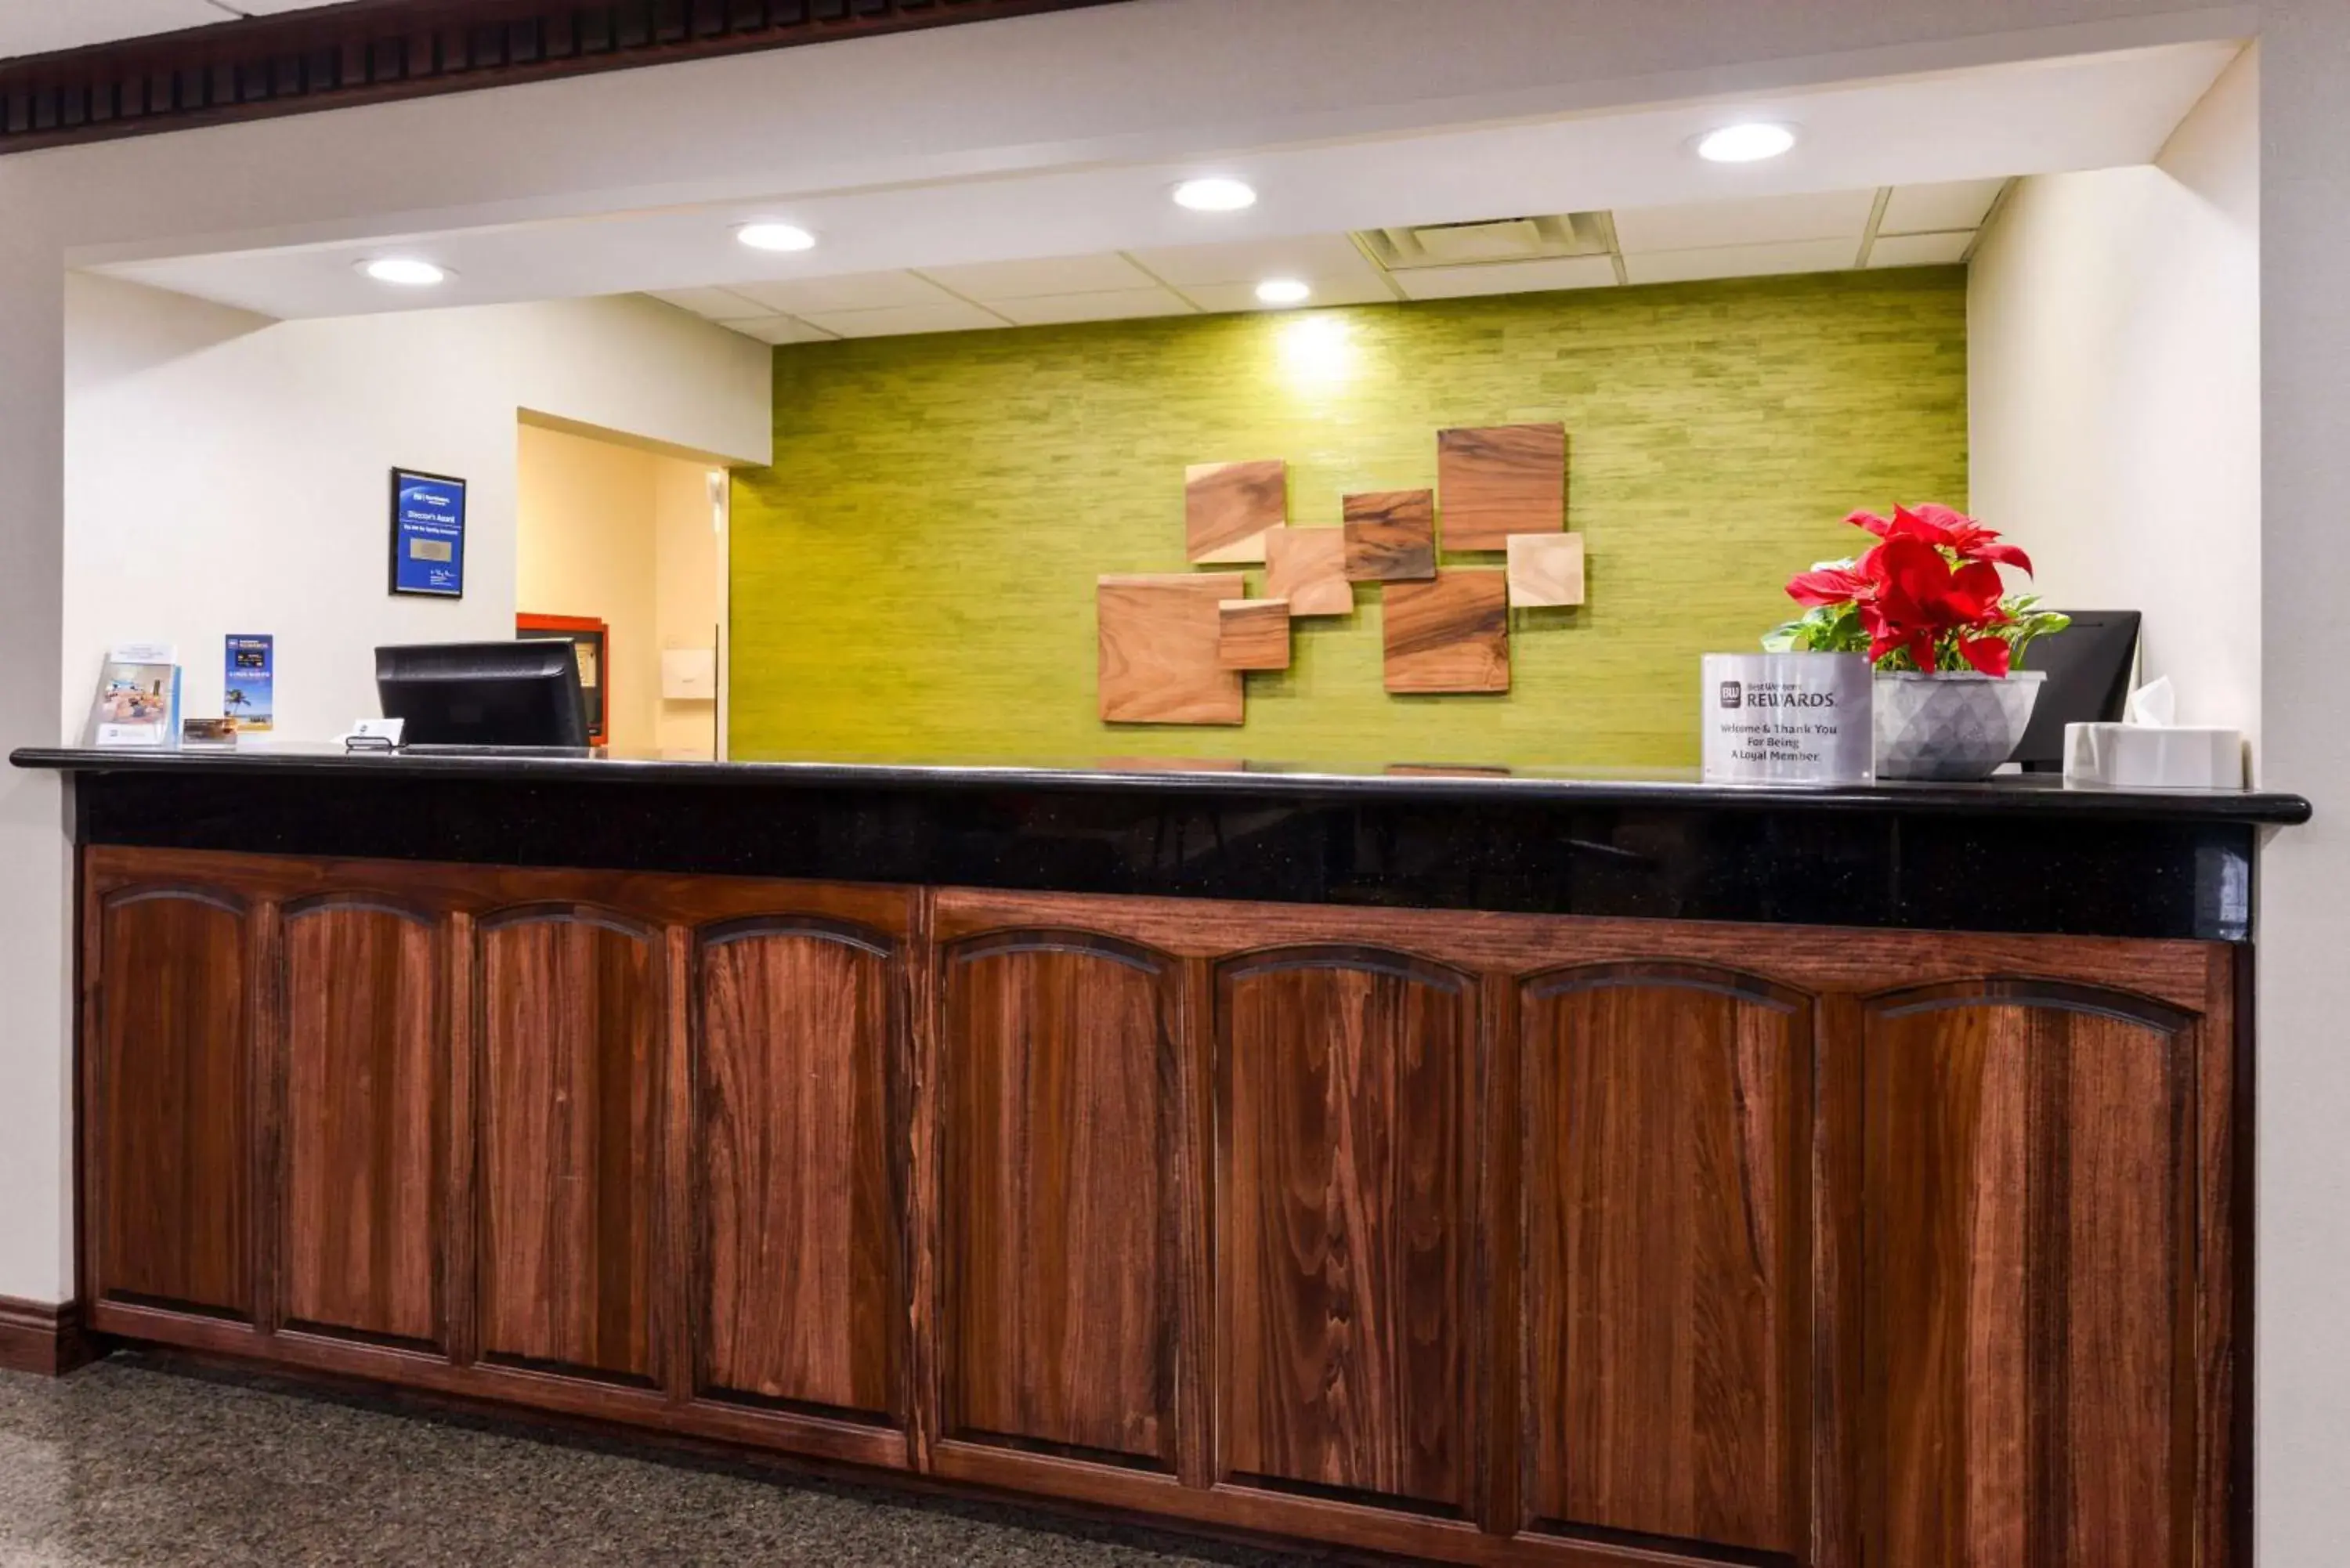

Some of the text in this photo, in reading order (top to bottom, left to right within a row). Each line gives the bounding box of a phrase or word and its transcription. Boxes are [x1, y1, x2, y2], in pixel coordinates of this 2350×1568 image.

[1747, 692, 1835, 708] REWARDS
[1720, 723, 1838, 735] Welcome & Thank You
[1747, 737, 1799, 750] For Being
[1731, 750, 1738, 760] A
[1740, 750, 1767, 762] Loyal
